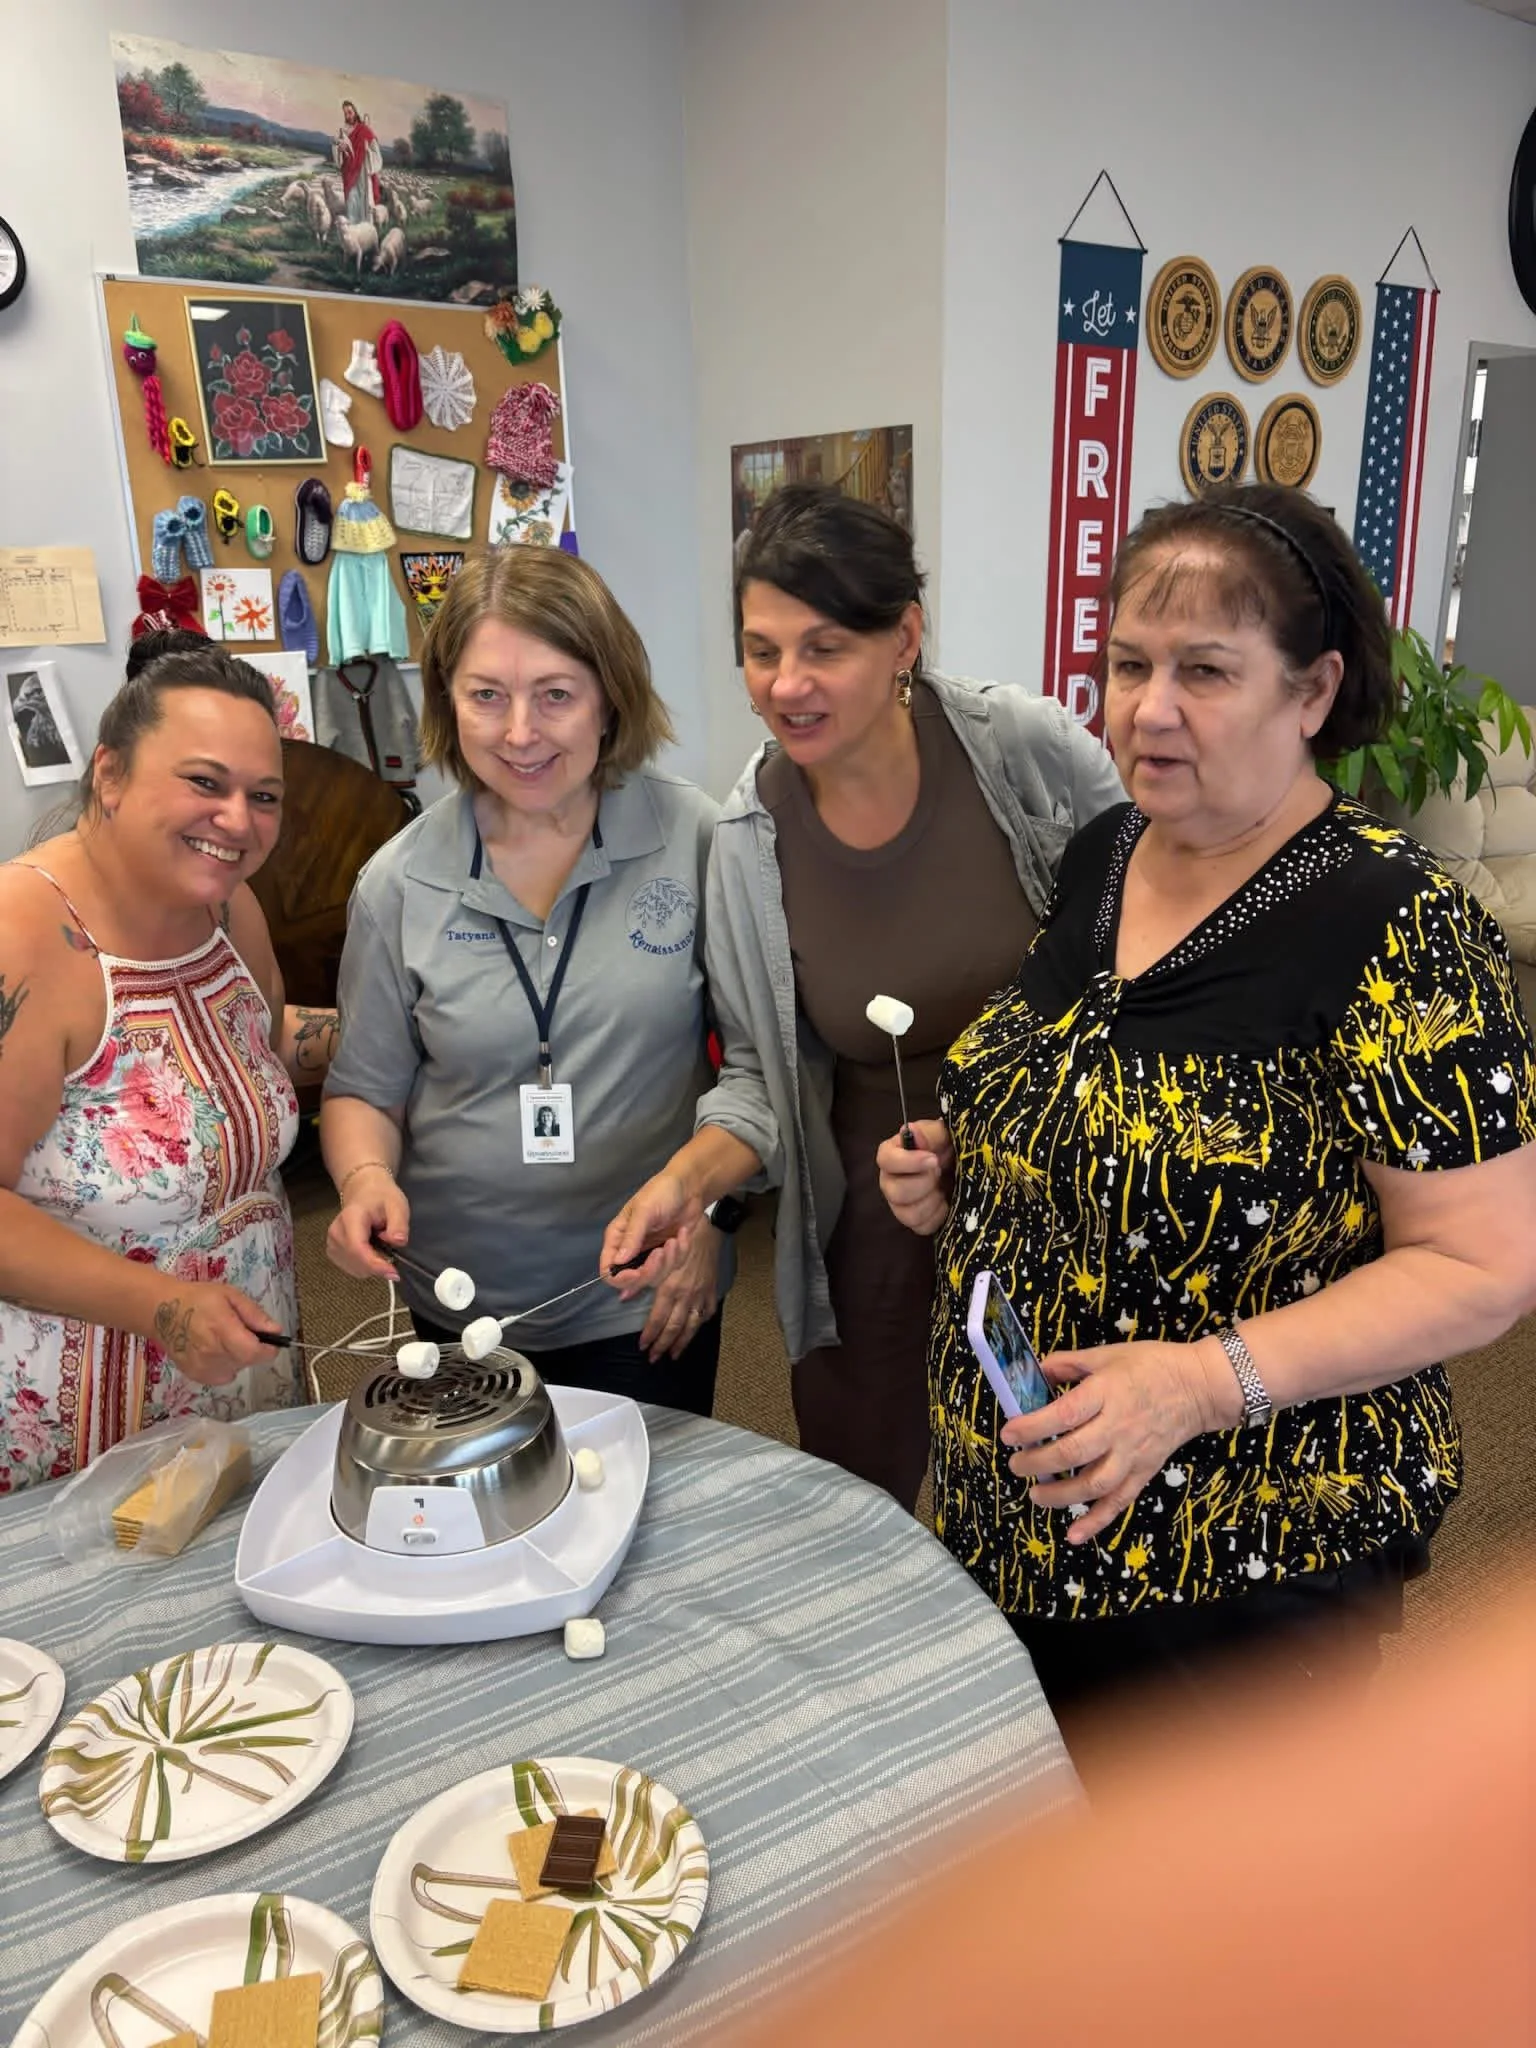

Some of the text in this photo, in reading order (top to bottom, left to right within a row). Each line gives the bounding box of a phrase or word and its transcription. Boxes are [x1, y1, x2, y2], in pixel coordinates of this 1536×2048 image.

[1082, 290, 1116, 336] Let
[447, 930, 496, 943] Tatyana
[628, 929, 696, 955] Renaissance
